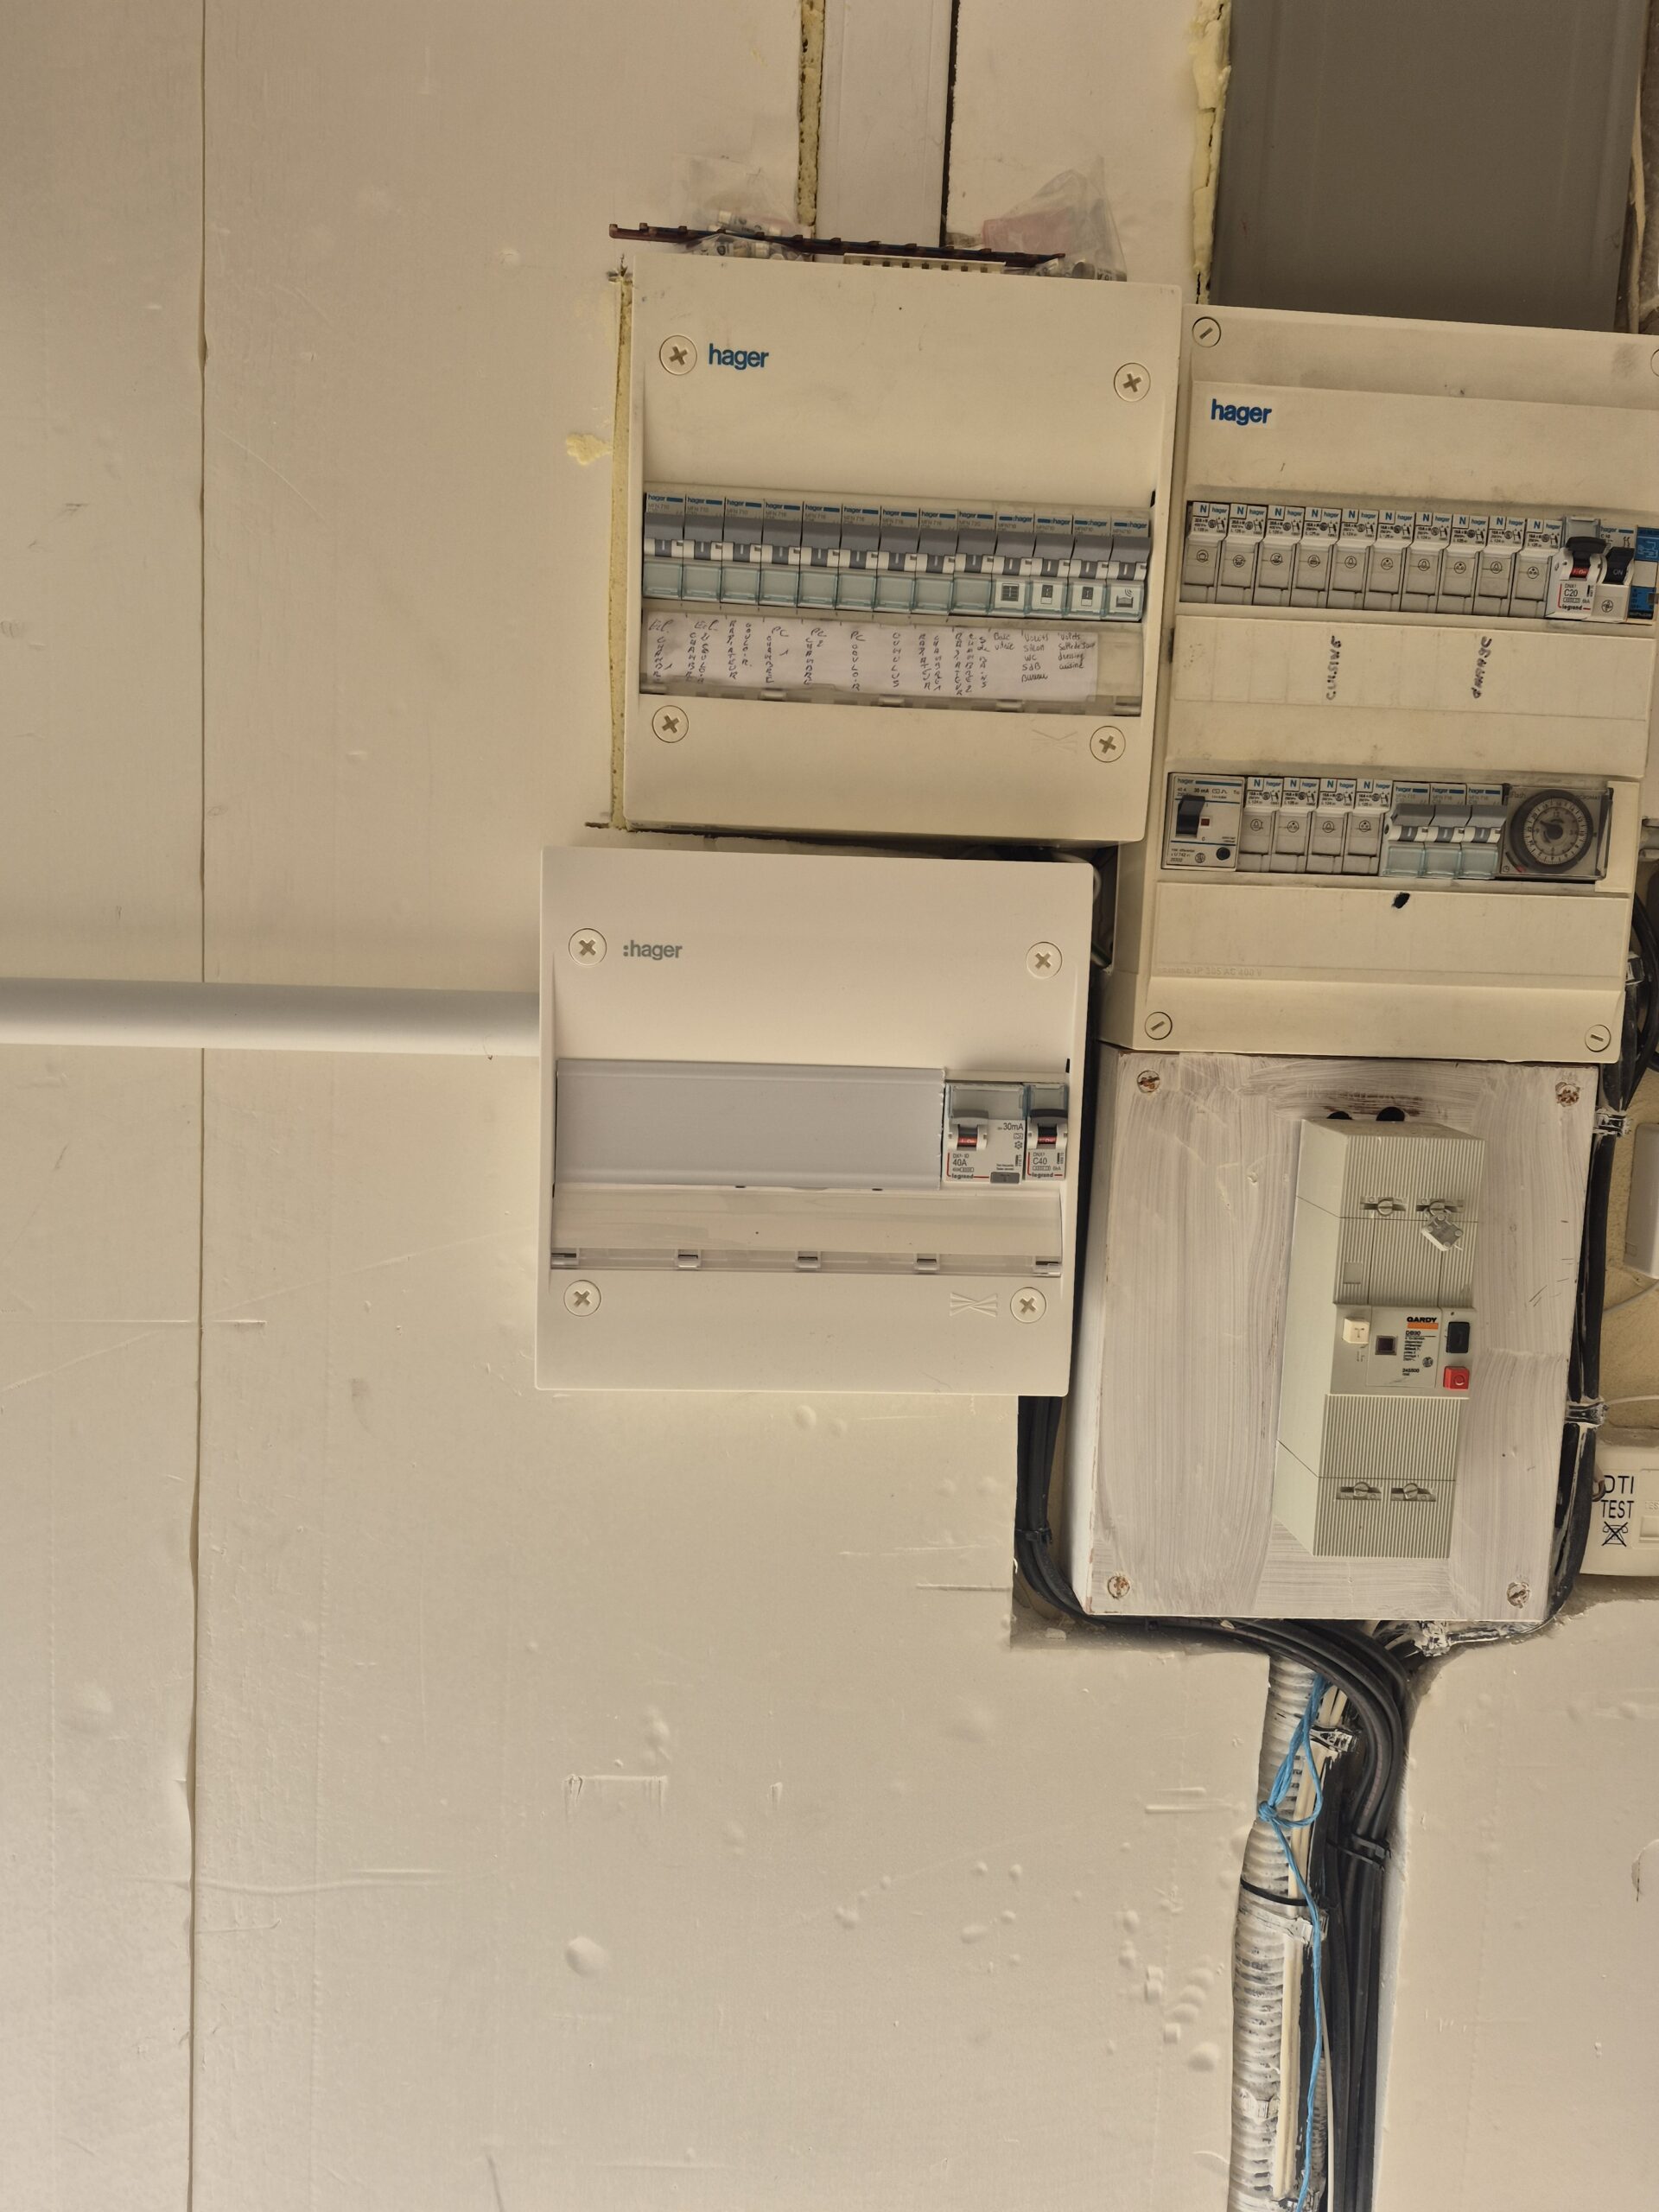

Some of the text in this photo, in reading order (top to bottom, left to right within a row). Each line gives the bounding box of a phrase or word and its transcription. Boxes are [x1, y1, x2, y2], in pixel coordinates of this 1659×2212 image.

[709, 344, 769, 371] hager
[1211, 398, 1272, 425] hager
[1200, 505, 1207, 513] N
[1237, 506, 1244, 515] N
[1274, 507, 1282, 517] N
[1312, 509, 1319, 518] N
[921, 510, 938, 518] hager
[1348, 510, 1355, 518] N
[1385, 512, 1392, 520] N
[1422, 513, 1430, 522] N
[1459, 517, 1466, 525] N
[1497, 517, 1503, 525] N
[1604, 1474, 1634, 1495] DTI
[1600, 1500, 1635, 1519] TEST
